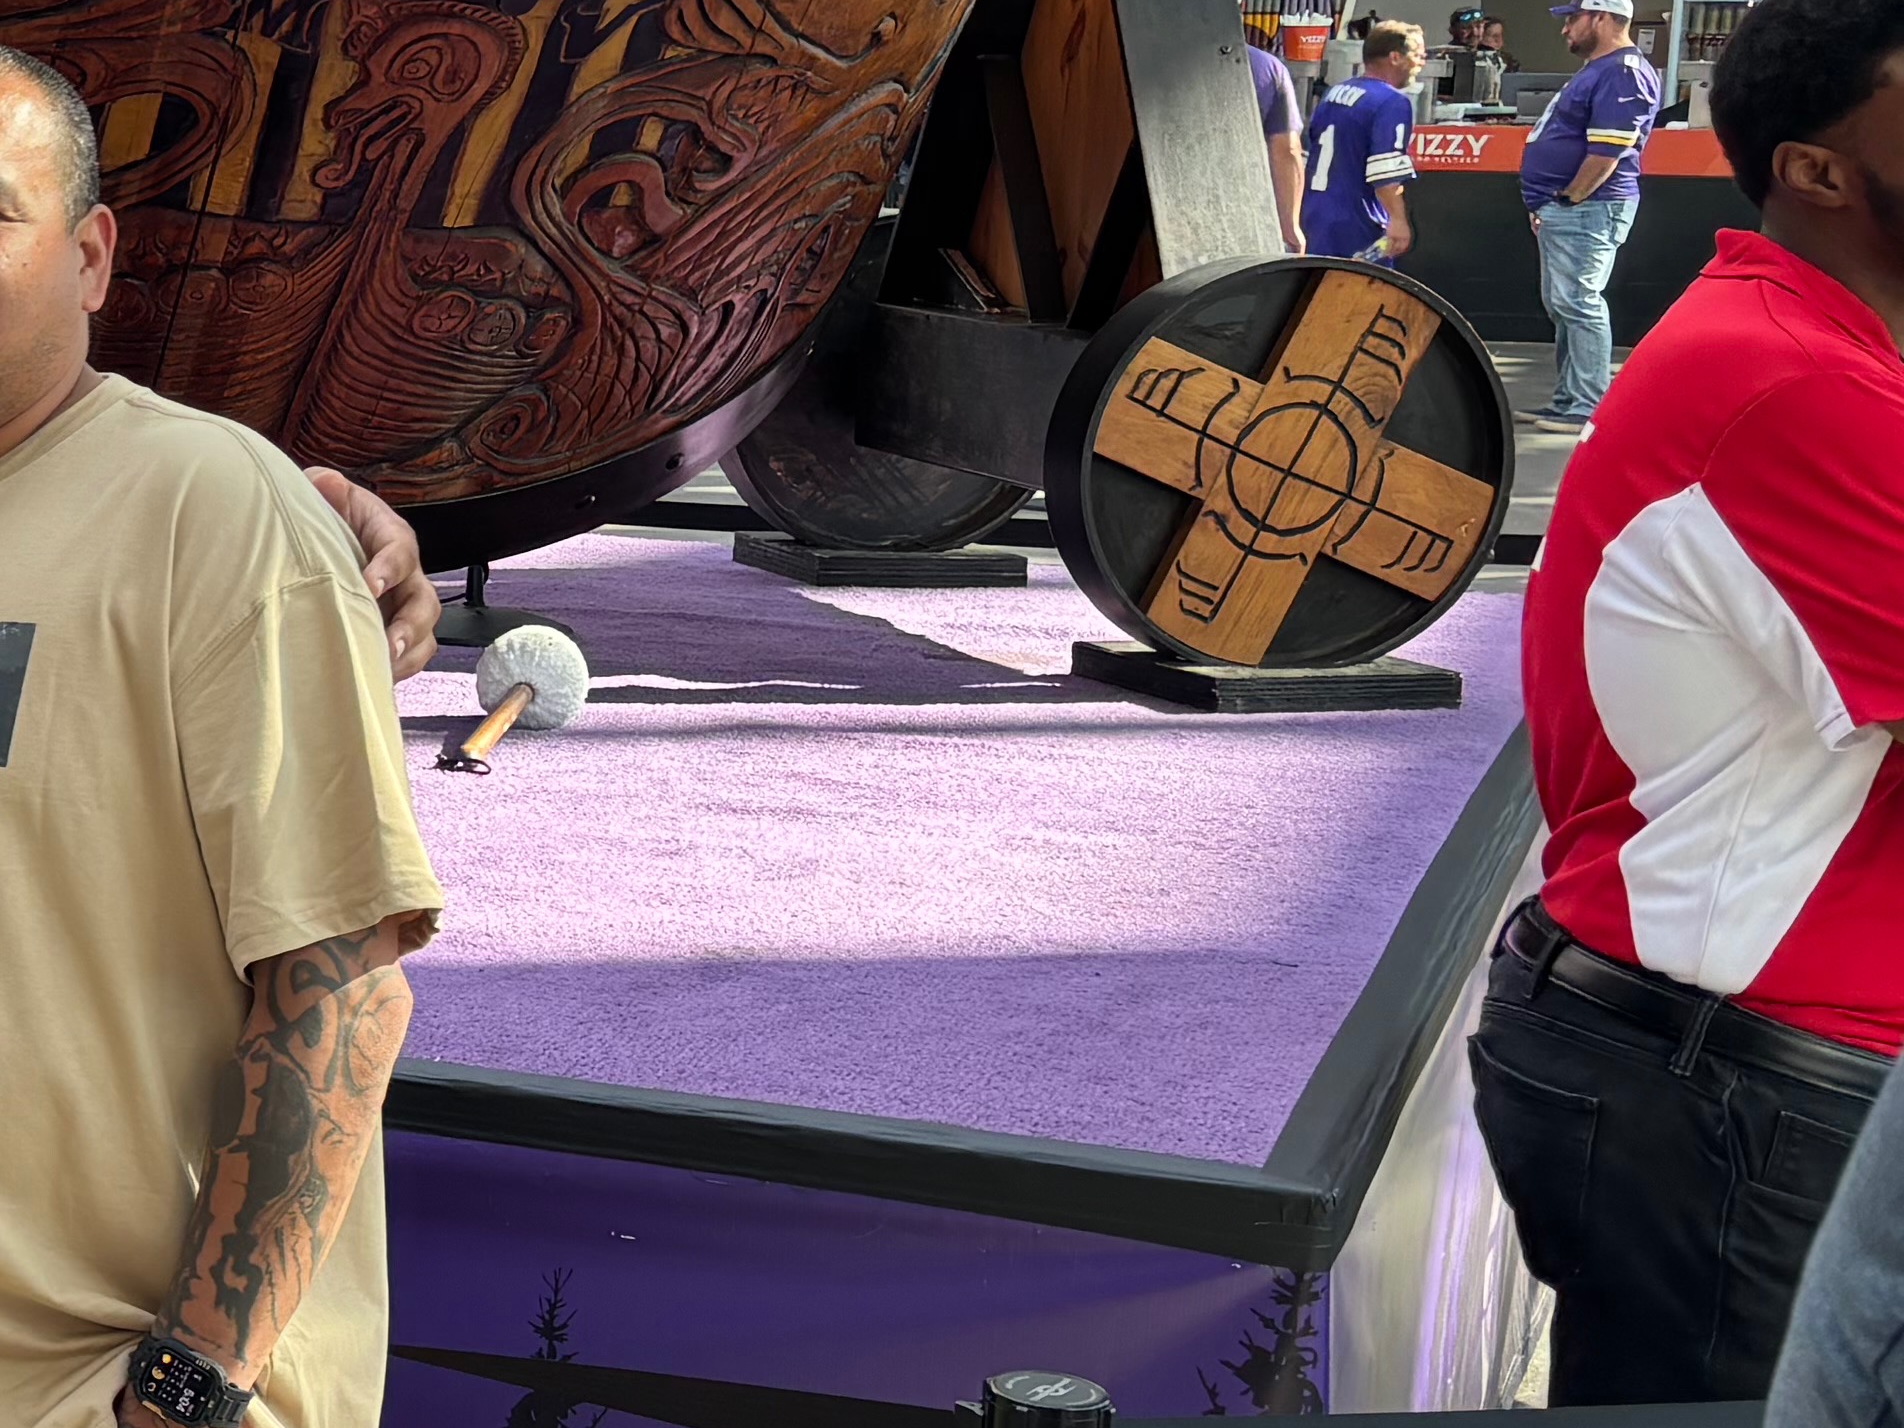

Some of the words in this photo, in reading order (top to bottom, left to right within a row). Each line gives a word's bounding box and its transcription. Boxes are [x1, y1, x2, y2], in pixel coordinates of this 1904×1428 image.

[1394, 123, 1405, 150] 1
[1409, 133, 1490, 157] IZZY
[1310, 124, 1335, 192] 1
